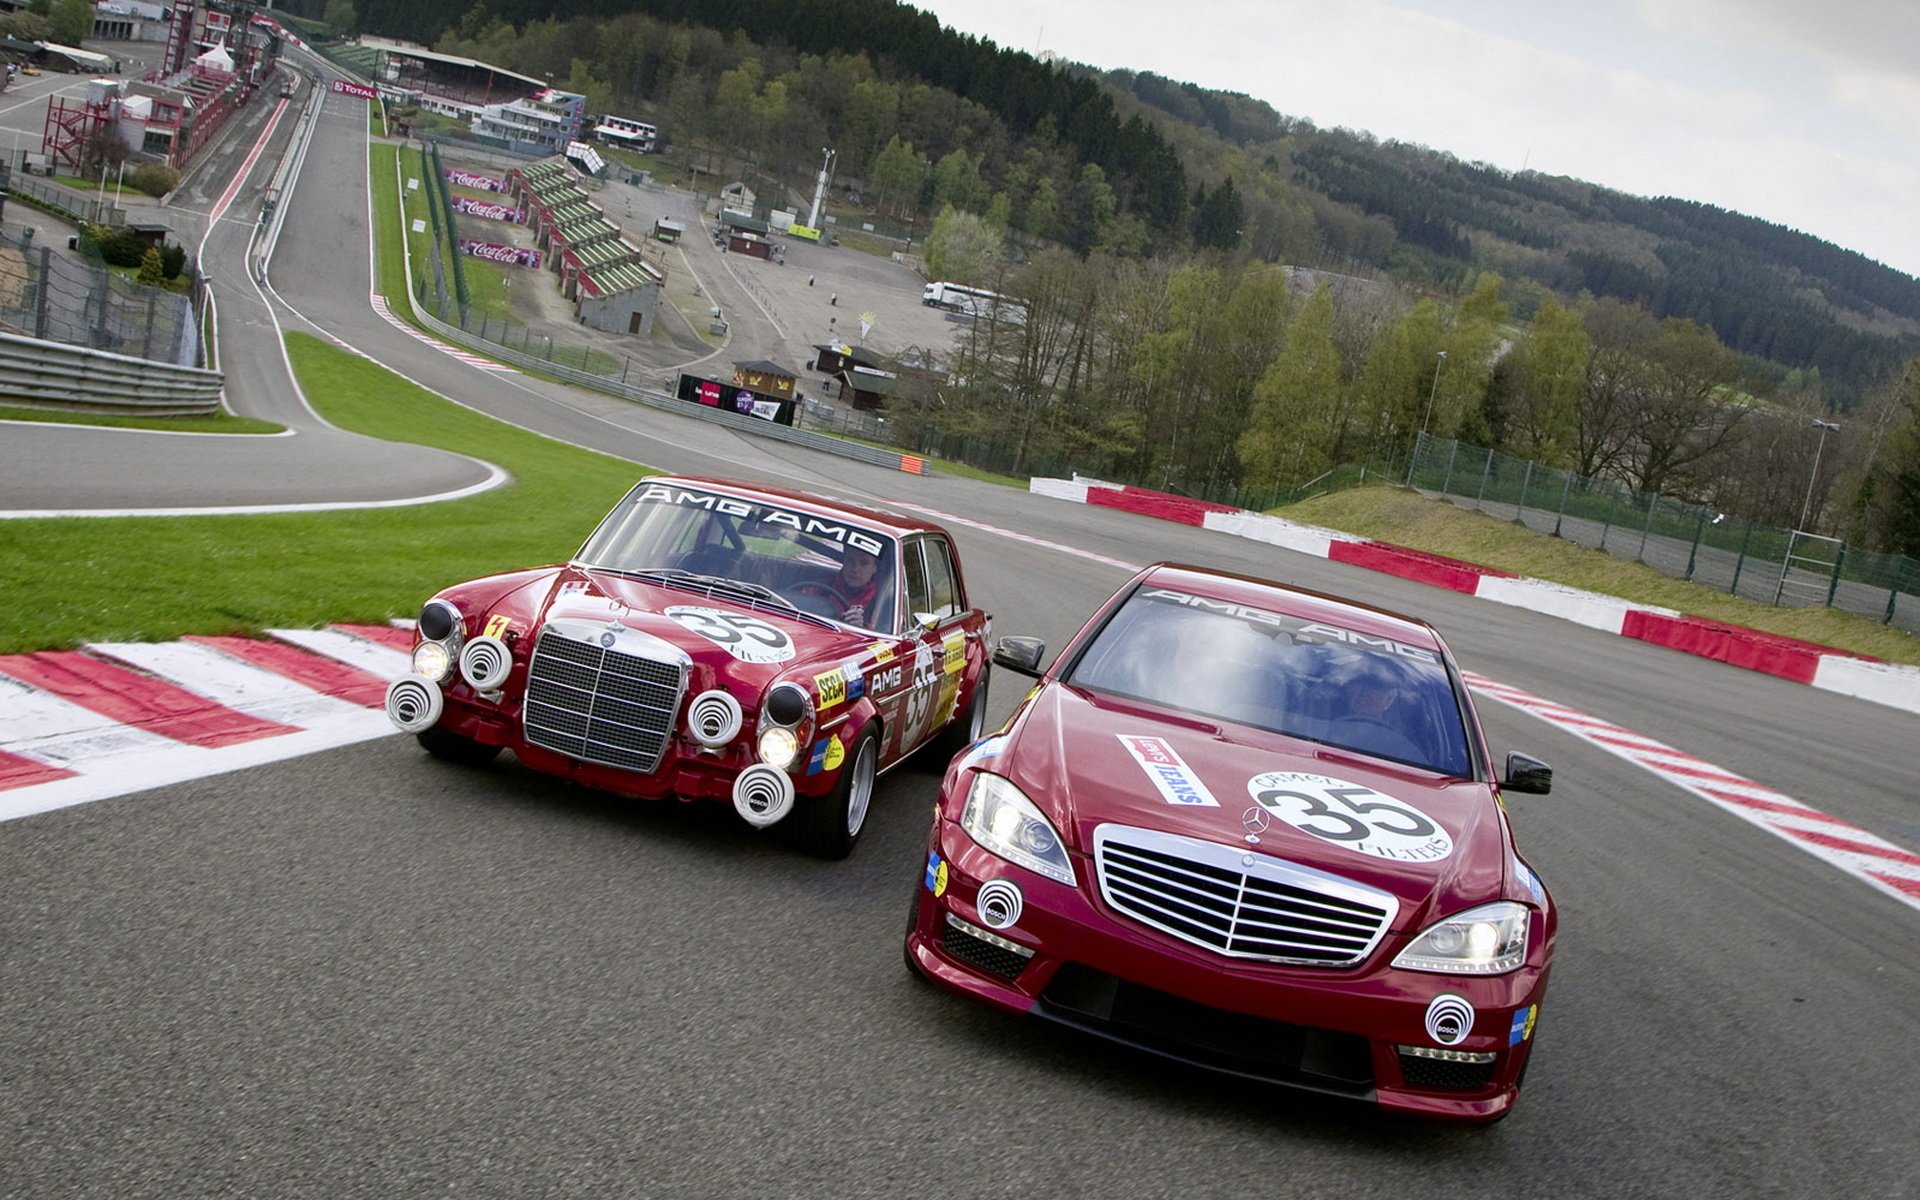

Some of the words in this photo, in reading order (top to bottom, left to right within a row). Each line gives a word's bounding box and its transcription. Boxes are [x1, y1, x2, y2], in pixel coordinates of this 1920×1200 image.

[344, 84, 375, 98] TOTAL
[636, 489, 753, 518] AMG
[762, 510, 883, 557] AMG
[669, 613, 788, 648] 35
[1142, 589, 1281, 626] AMG
[1298, 624, 1437, 663] AMG
[870, 666, 902, 695] AMG
[1154, 765, 1203, 804] JEANS
[1257, 788, 1435, 841] 35
[986, 907, 1006, 920] BOSCH
[1437, 1025, 1458, 1034] BOSCH
